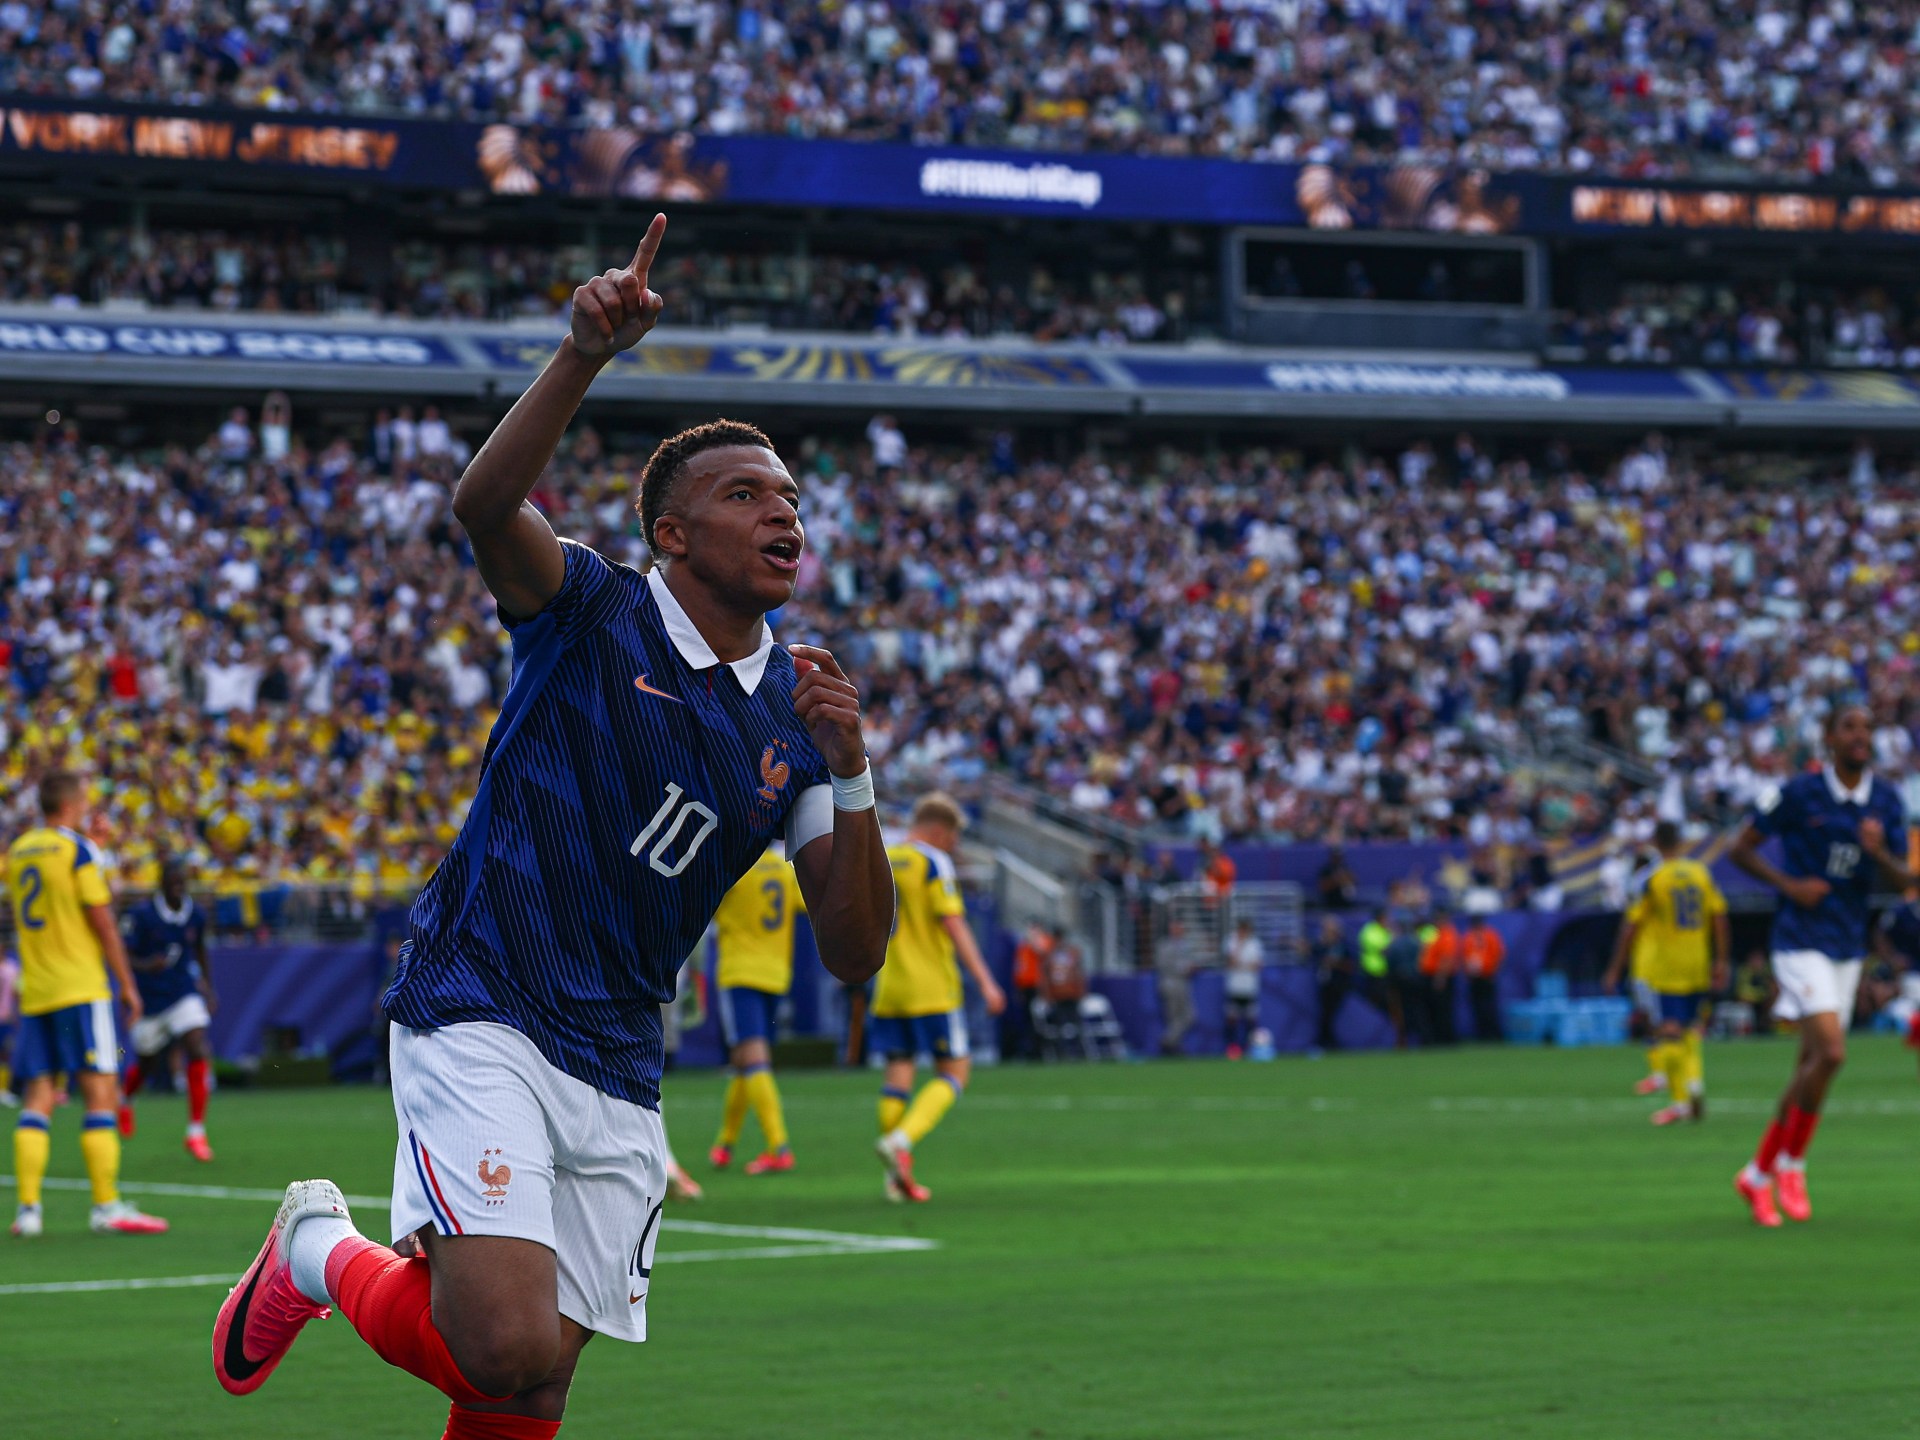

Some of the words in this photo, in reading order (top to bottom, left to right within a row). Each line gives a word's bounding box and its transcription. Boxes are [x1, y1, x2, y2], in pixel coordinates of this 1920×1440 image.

[8, 109, 129, 154] YORK
[133, 116, 233, 160] NEW
[236, 122, 398, 170] JERSEY
[115, 326, 228, 355] CUP
[235, 332, 431, 364] 2026
[630, 782, 718, 877] 10
[20, 866, 46, 931] 2
[761, 880, 785, 930] 3
